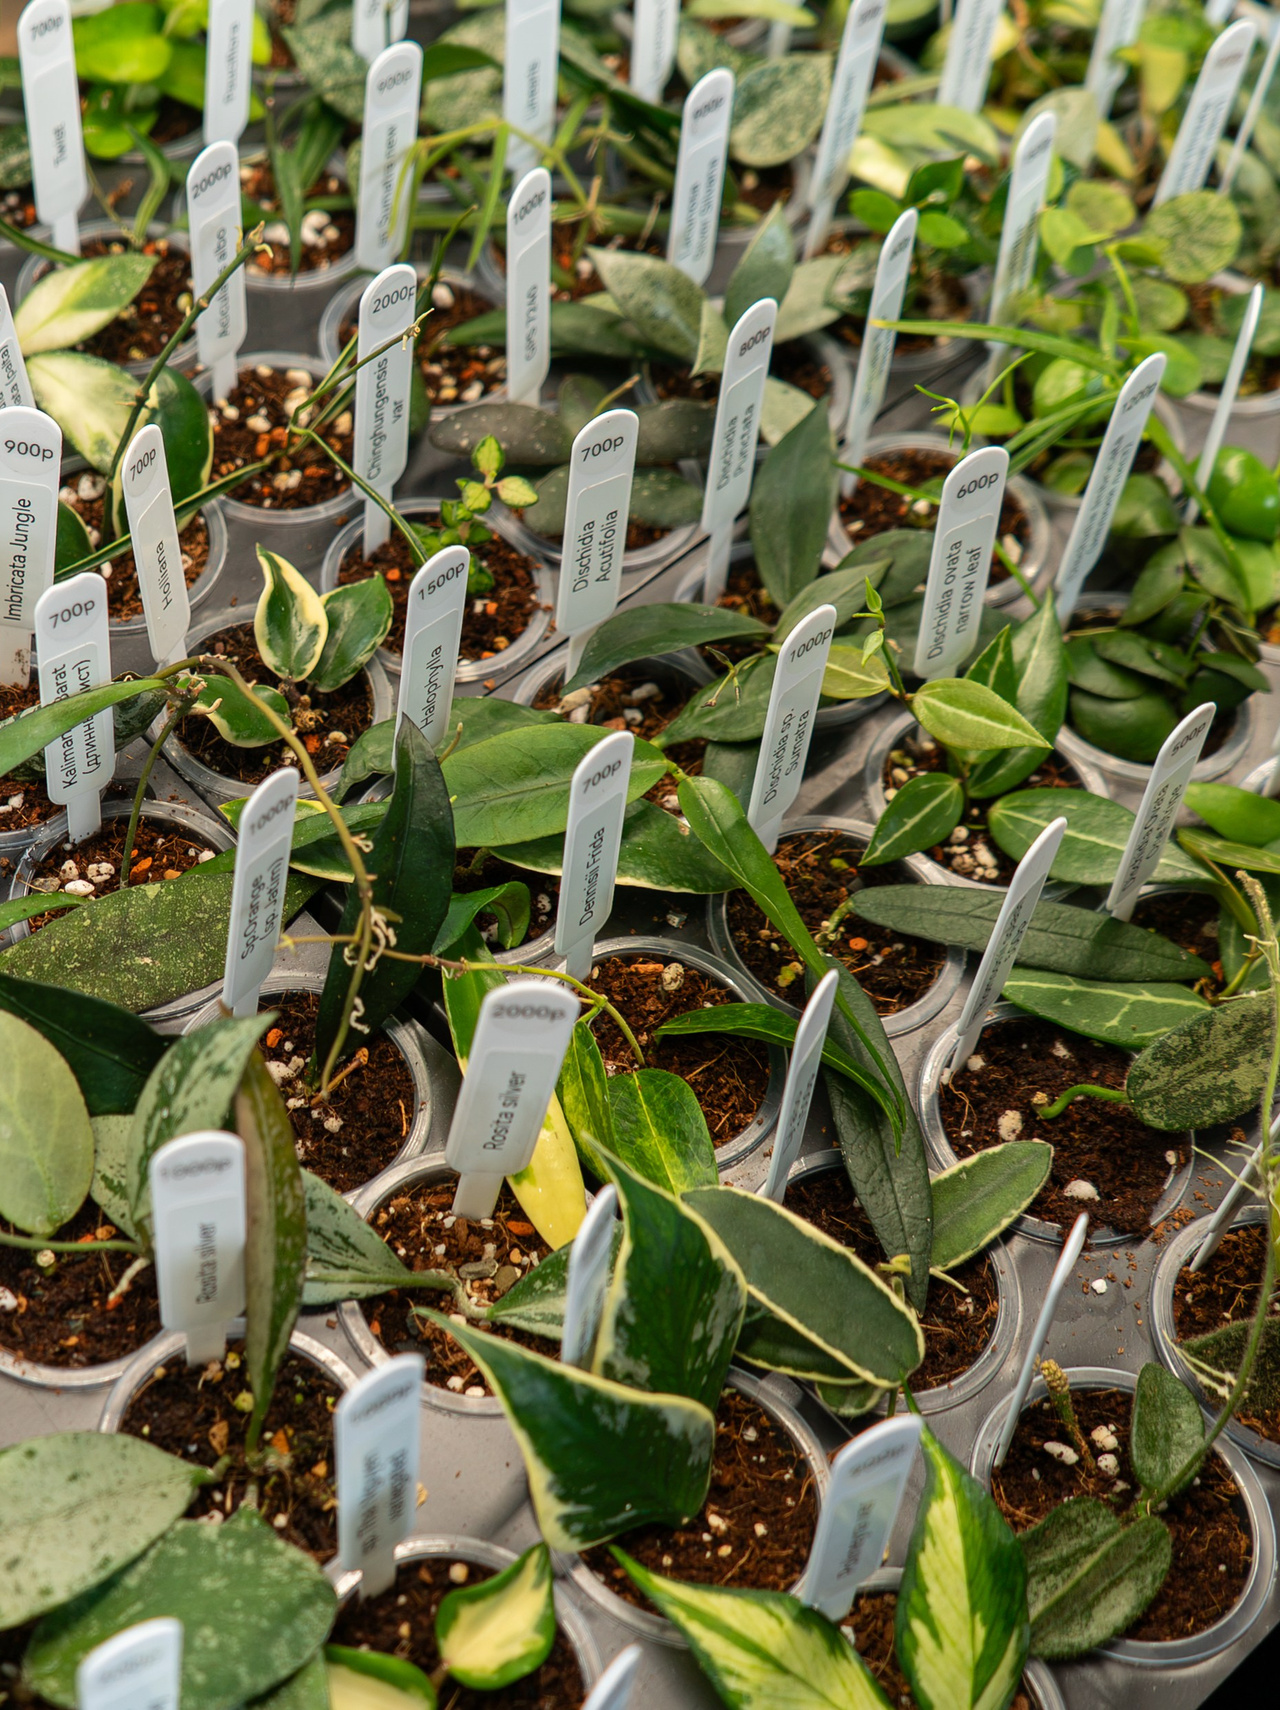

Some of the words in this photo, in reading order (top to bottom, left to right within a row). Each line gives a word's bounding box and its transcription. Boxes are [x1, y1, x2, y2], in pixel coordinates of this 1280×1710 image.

[30, 15, 64, 41] 700p
[191, 162, 232, 200] 2000p
[512, 189, 547, 227] 1000p
[215, 227, 228, 263] albo
[217, 262, 231, 338] Aciculas
[373, 284, 416, 315] 2000p
[739, 326, 771, 358] 800p
[367, 357, 389, 481] Chinghungensis
[391, 399, 406, 425] var
[4, 439, 54, 462] 900p
[130, 448, 157, 483] 700p
[581, 434, 625, 463] 700p
[956, 471, 1000, 500] 600p
[10, 498, 36, 552] Jungle
[572, 519, 597, 594] Dischidia
[594, 509, 619, 585] Acutifolia
[963, 546, 983, 581] leaf
[3, 555, 27, 622] Imbricata
[156, 540, 173, 612] Holliana
[417, 561, 466, 602] 1500p
[49, 599, 96, 629] 700p
[926, 587, 953, 661] Dischidia
[944, 539, 964, 584] ovata
[954, 582, 976, 635] narrow
[789, 627, 832, 664] 1000p
[763, 732, 790, 806] Dischidia
[780, 707, 796, 734] sp.
[784, 709, 811, 777] Sumatra
[1171, 721, 1207, 758] 500p
[581, 759, 623, 795] 700p
[249, 794, 295, 837] 1000p
[1147, 783, 1170, 831] Ovata
[586, 826, 606, 869] Frida
[578, 867, 601, 928] Dennisii
[492, 1003, 567, 1024] 2000p
[483, 1108, 514, 1151] Rosita
[499, 1069, 528, 1111] silver
